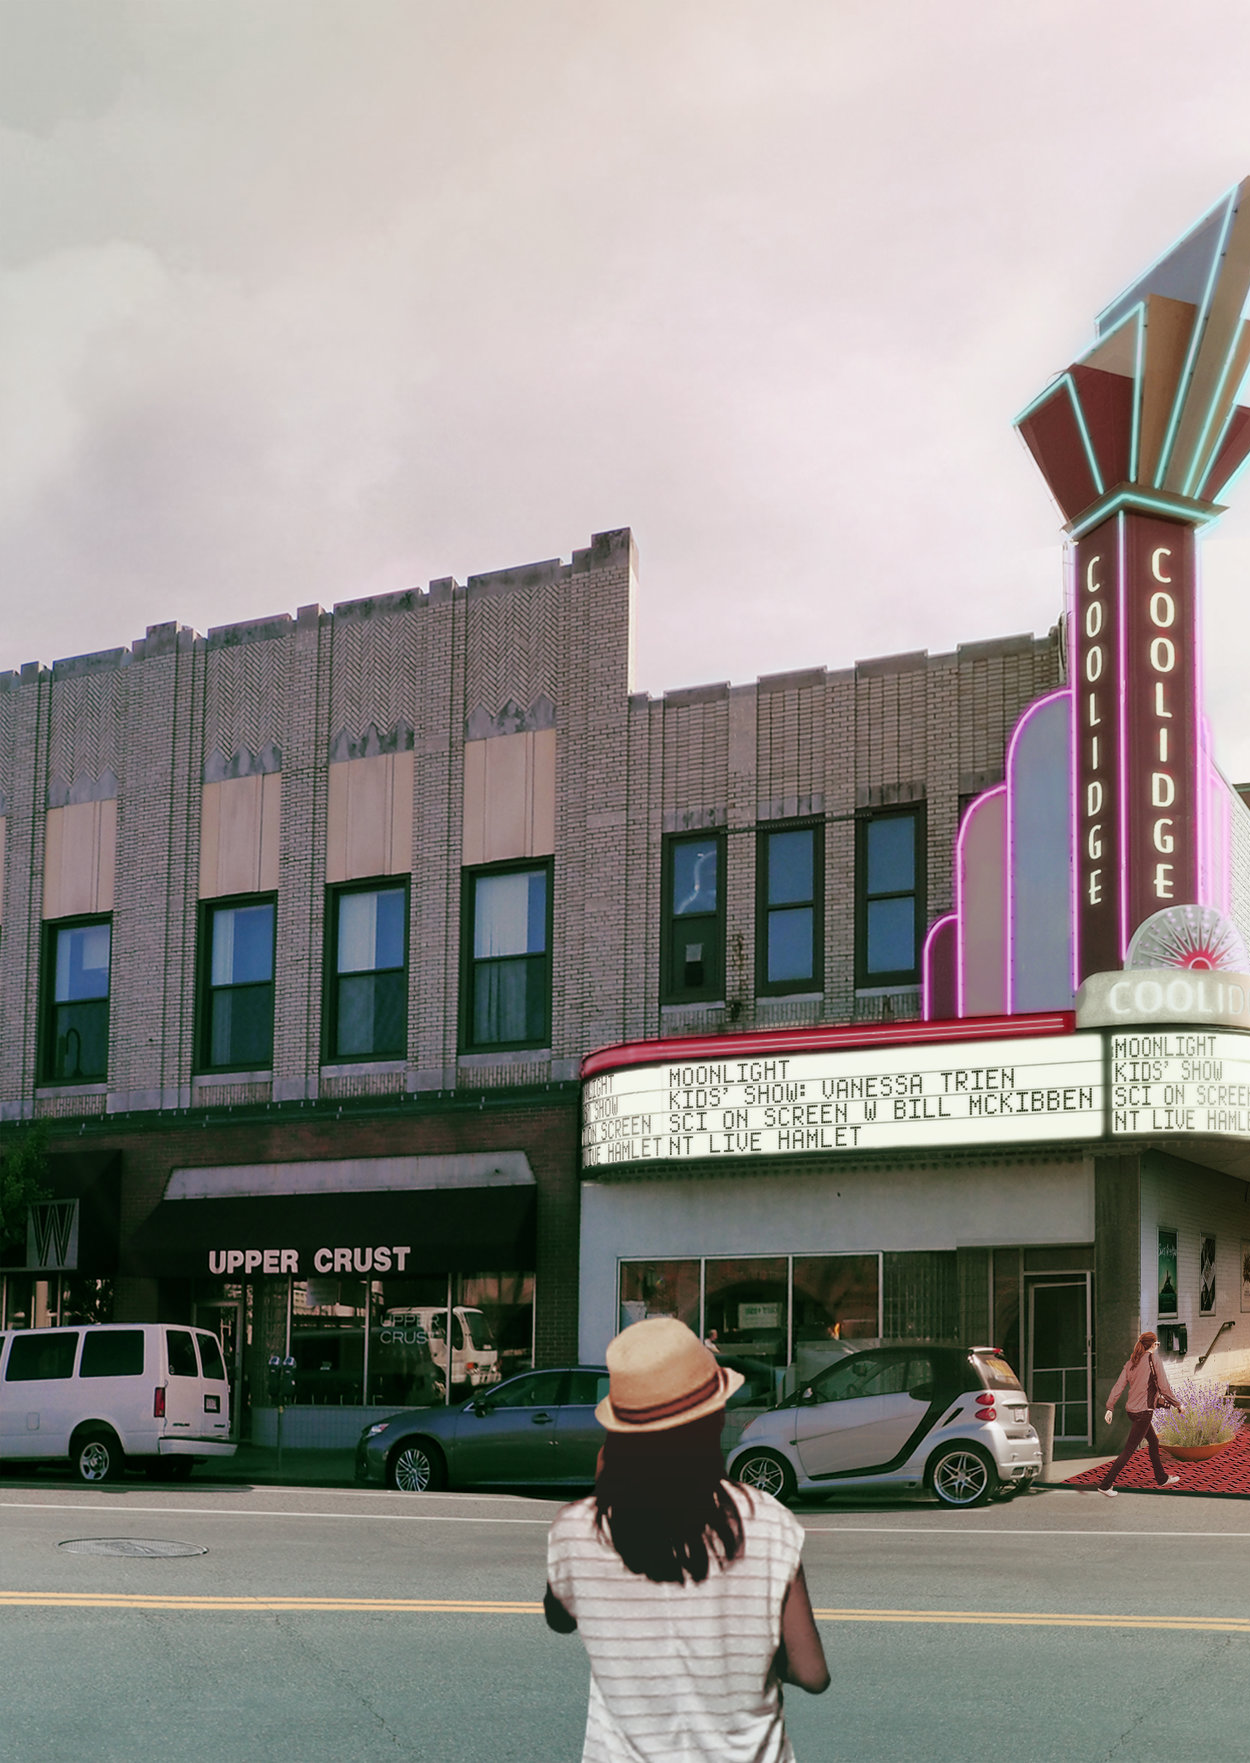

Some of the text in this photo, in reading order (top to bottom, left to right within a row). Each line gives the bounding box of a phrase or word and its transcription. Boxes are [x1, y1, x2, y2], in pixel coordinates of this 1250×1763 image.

[1086, 556, 1104, 905] COOLIDGE
[1149, 547, 1176, 899] COOLIDGE
[1114, 1036, 1216, 1058] MOONLIGHT
[669, 1060, 790, 1088] MOONLIGHT
[1114, 1060, 1223, 1082] KIDS' SHOW
[669, 1068, 1015, 1110] KIDS' SHOW: VANESSA TRIEN
[1115, 1086, 1151, 1107] SCI
[1164, 1085, 1185, 1105] ON
[669, 1088, 1093, 1133] SCI ON SCREEN W BILL MCKIBBEN
[1114, 1110, 1140, 1132] NT
[1152, 1110, 1195, 1130] LIVE
[601, 1115, 651, 1140] SCREEN
[669, 1126, 861, 1156] NT LIVE HAMLET
[608, 1138, 662, 1163] HAMLET
[31, 1203, 76, 1267] W
[208, 1246, 412, 1275] UPPER CRUST
[380, 1314, 440, 1327] UPPER
